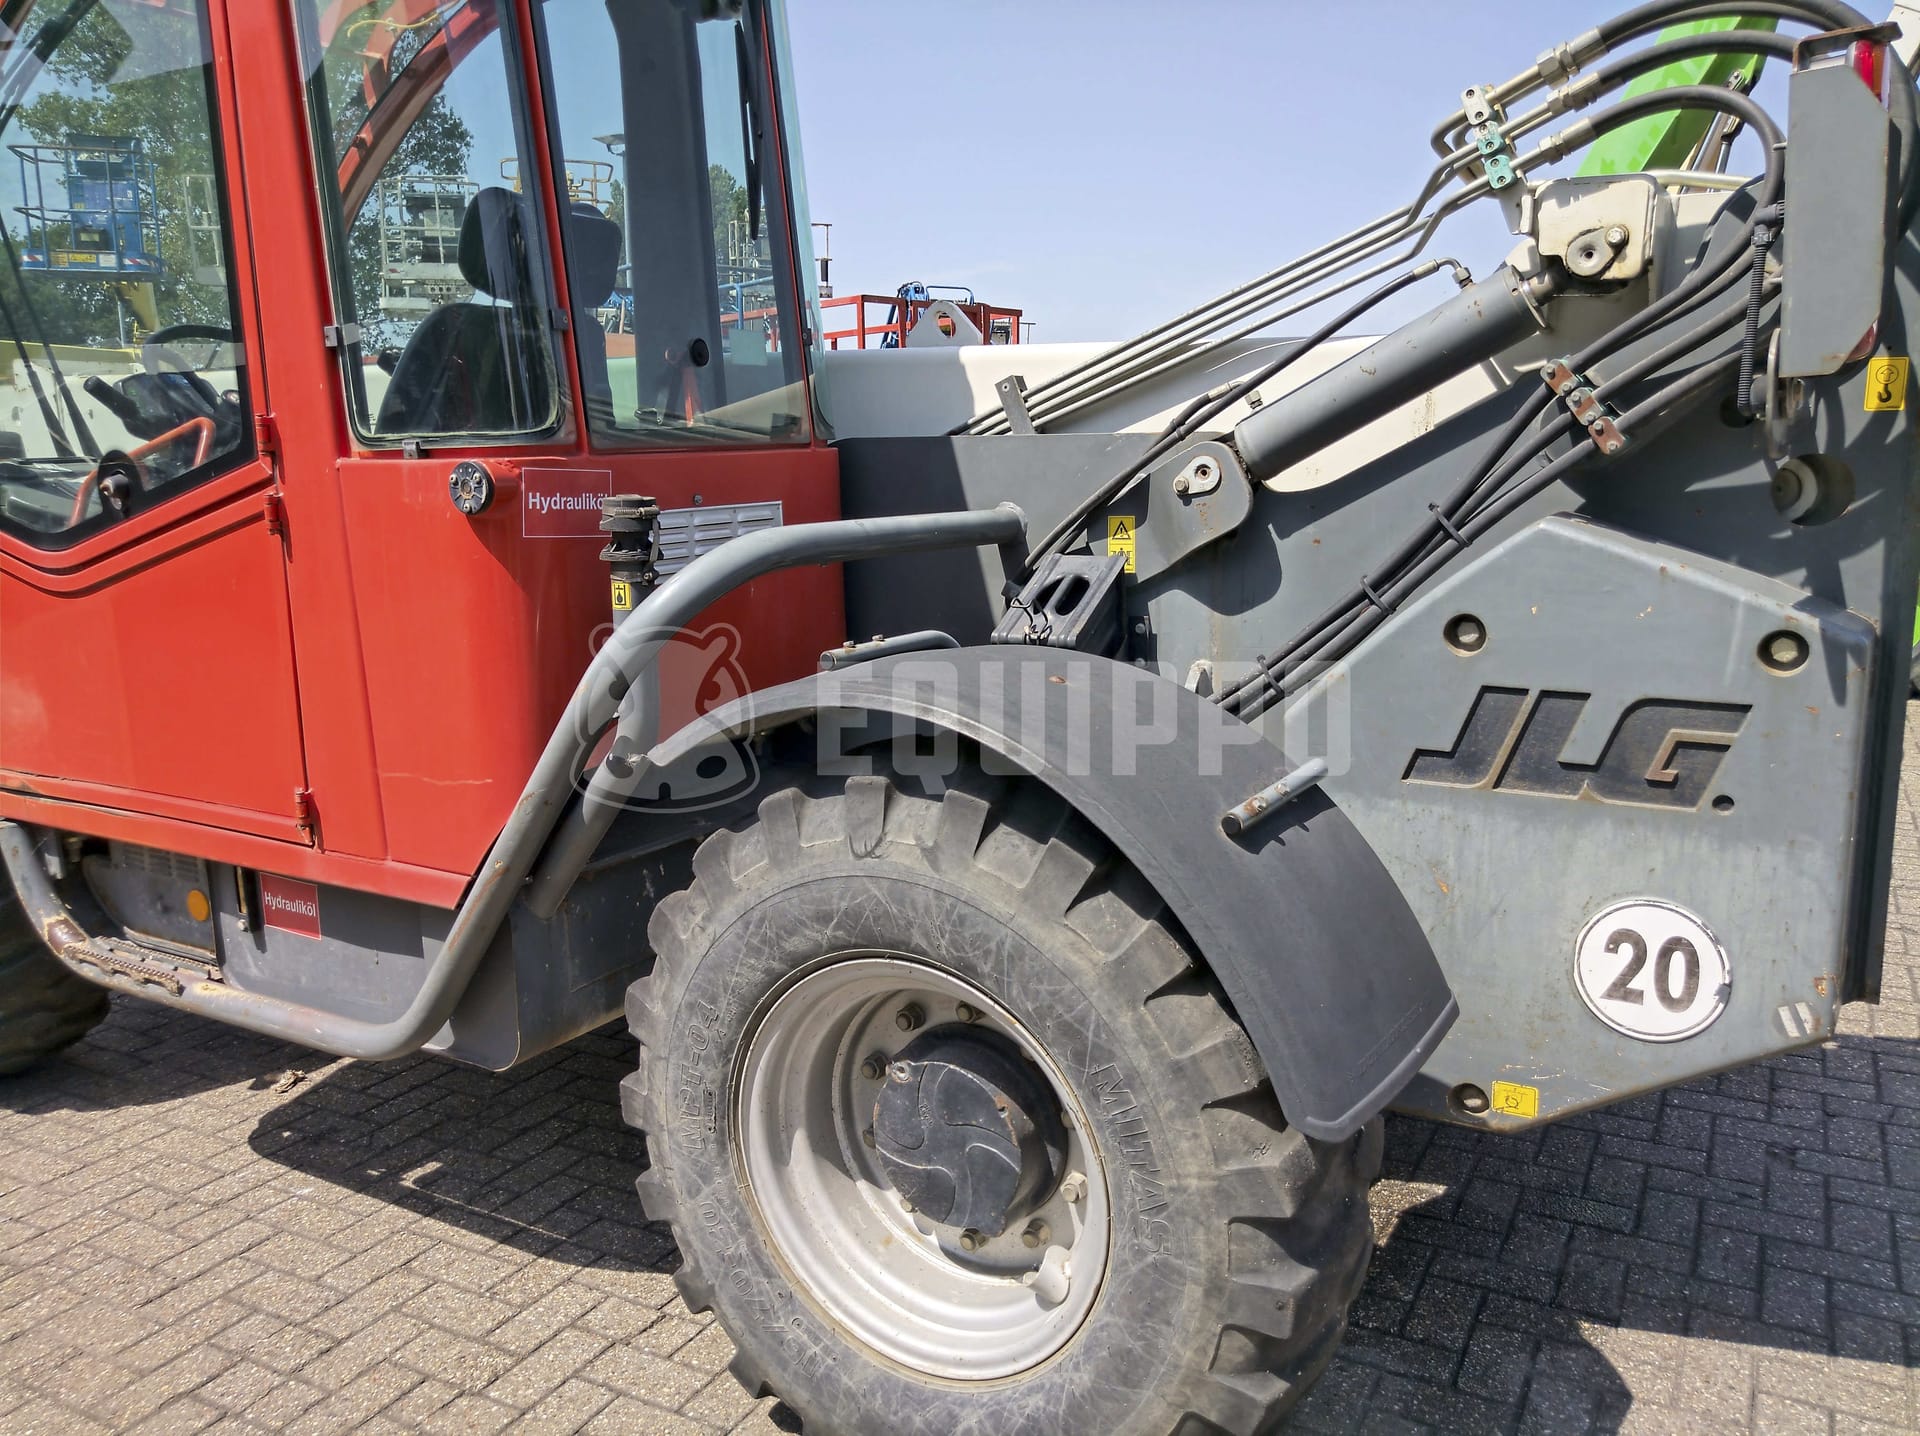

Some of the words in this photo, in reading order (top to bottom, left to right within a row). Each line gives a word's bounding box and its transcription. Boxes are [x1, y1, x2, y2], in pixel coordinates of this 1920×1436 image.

[1401, 685, 1753, 812] JLG
[264, 891, 316, 917] Hydrauliköl
[1600, 928, 1701, 1014] 20
[680, 1000, 719, 1150] MPT-04
[1090, 1063, 1173, 1256] MITAS
